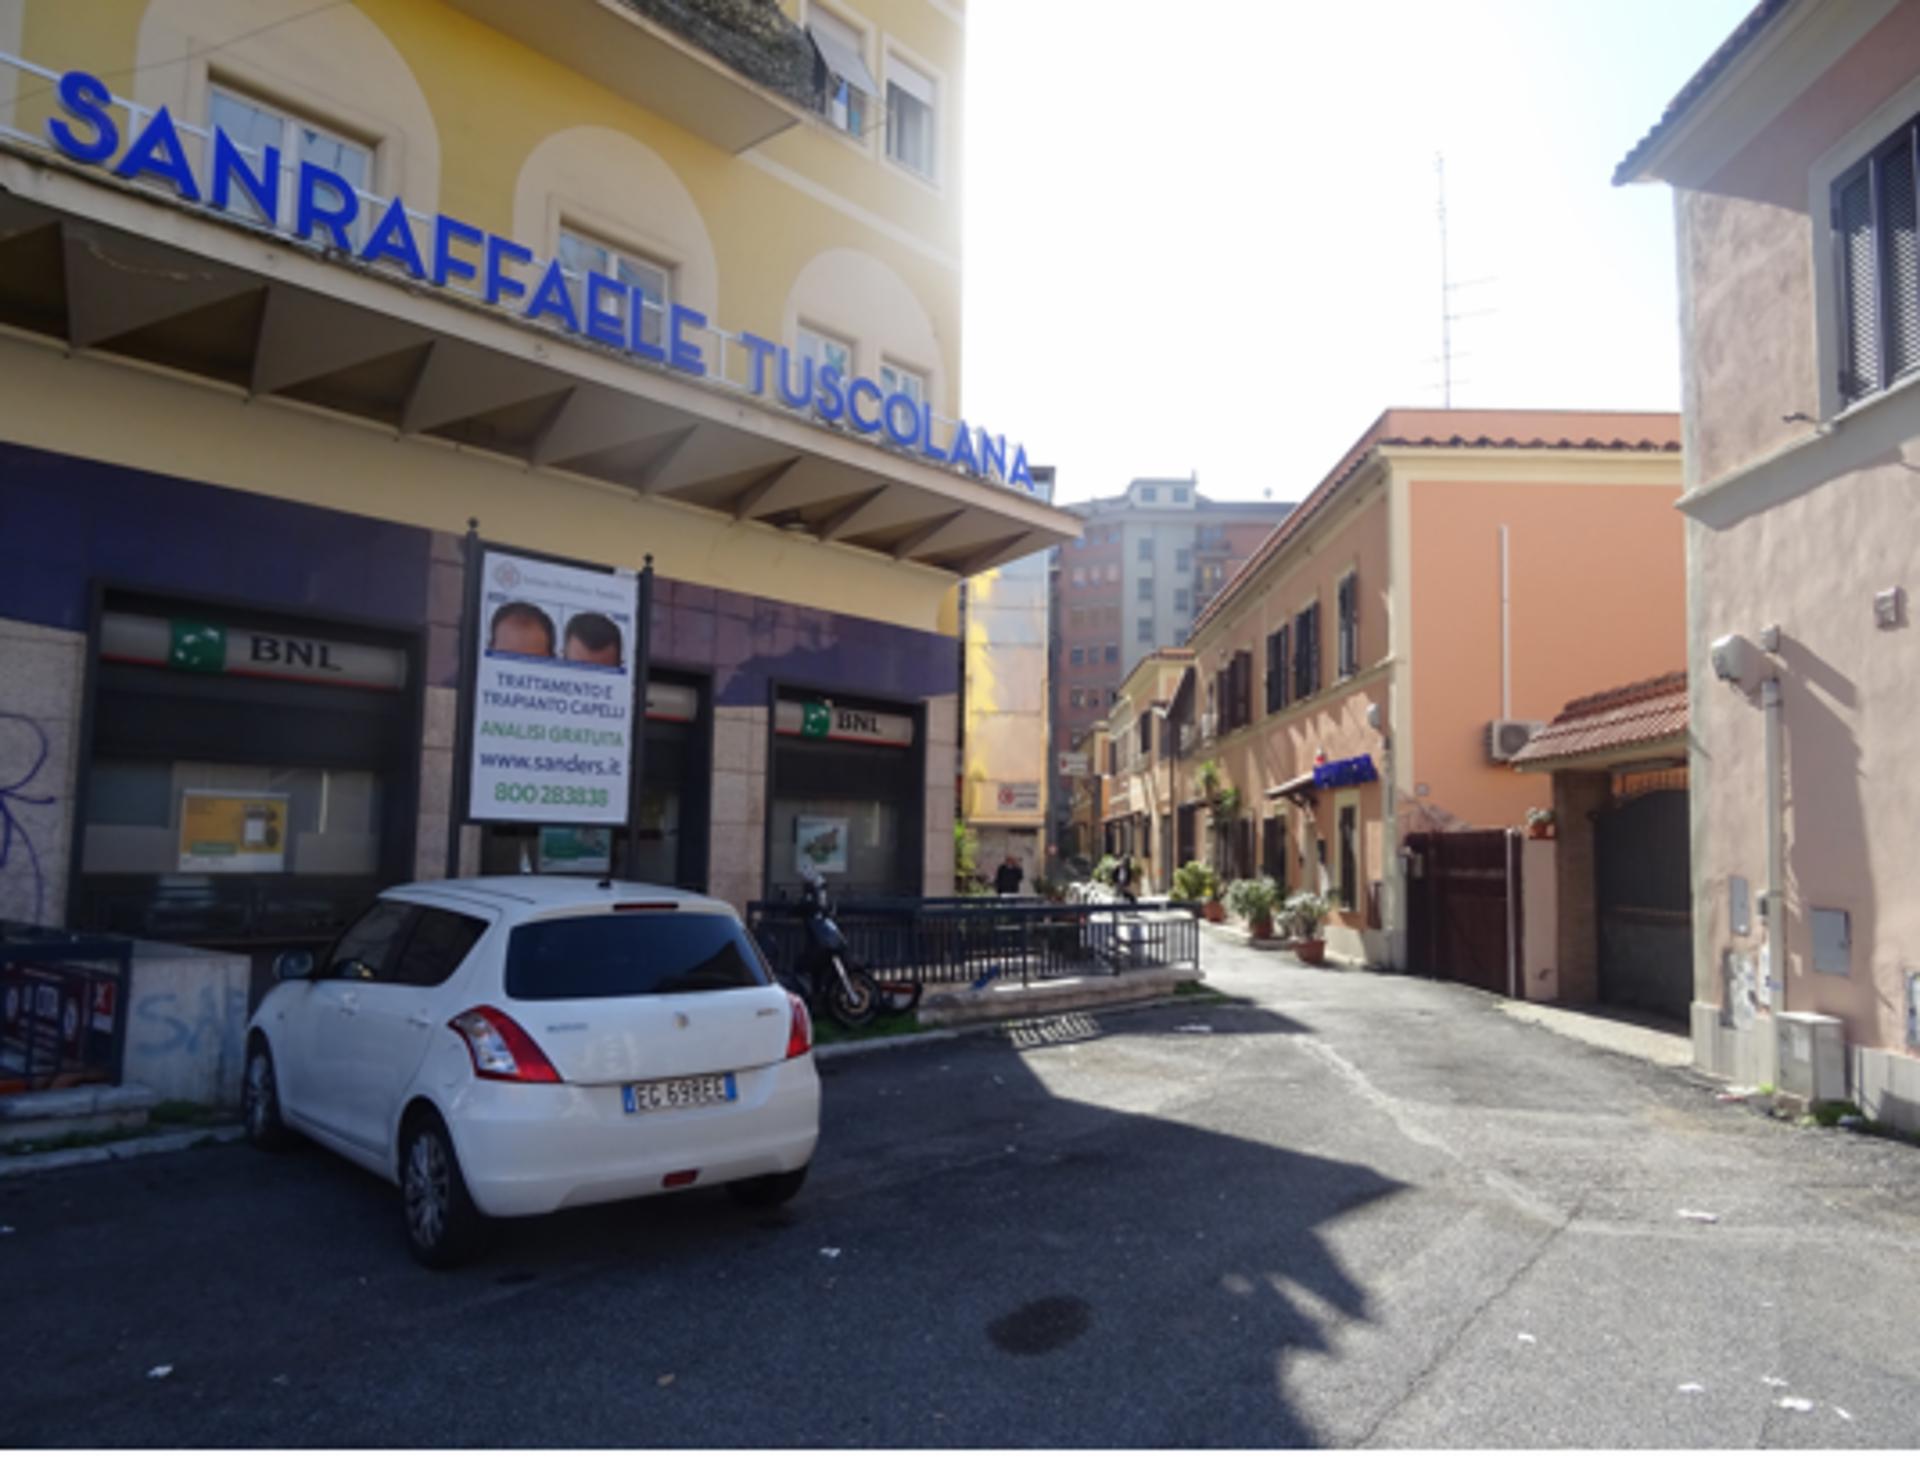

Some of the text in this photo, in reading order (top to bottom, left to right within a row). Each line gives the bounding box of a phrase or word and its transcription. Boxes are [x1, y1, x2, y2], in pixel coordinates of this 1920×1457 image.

[741, 331, 1035, 491] TUSCOLANA
[250, 635, 343, 672] BNL
[497, 672, 602, 698] TRATTAMENTO
[483, 690, 625, 718] TRAPIANTO CAPELLI
[480, 720, 546, 741] ANALISI
[838, 713, 881, 735] BNL
[480, 753, 622, 777] www.sanders.it
[494, 781, 538, 804] 800
